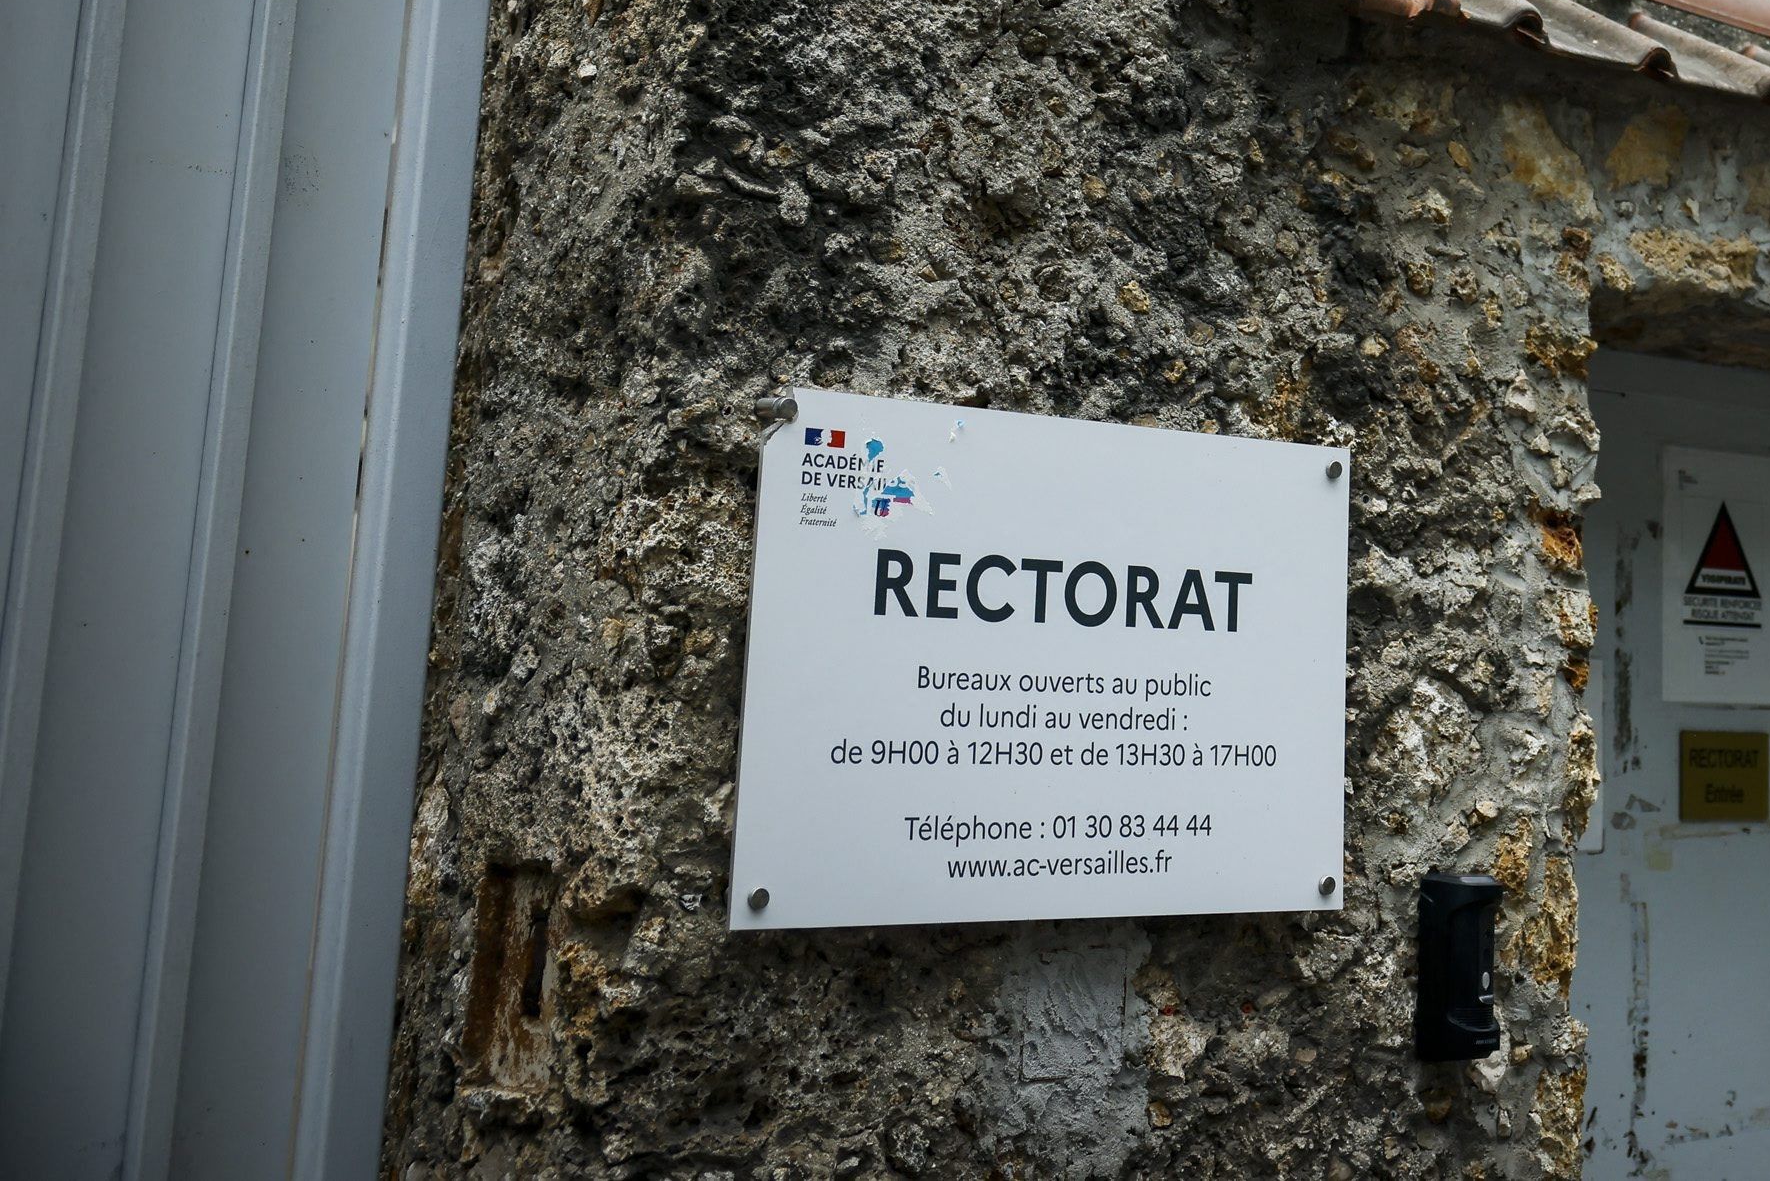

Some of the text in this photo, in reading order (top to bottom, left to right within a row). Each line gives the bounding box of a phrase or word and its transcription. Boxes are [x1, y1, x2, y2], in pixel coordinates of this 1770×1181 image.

[801, 471, 821, 486] DE
[800, 503, 828, 516] Égalité
[801, 492, 828, 503] Liberté
[799, 516, 838, 527] Fraternité
[873, 548, 1253, 633] RECTORAT
[917, 665, 1212, 703] Bureaux ouverts au public
[939, 702, 971, 728] du
[979, 702, 1037, 729] lundi
[1044, 711, 1071, 730] au
[1078, 706, 1176, 731] vendredi
[830, 738, 1277, 767] de 9H00 à 12H30 et de 13H30 à 17H00
[1689, 747, 1759, 769] RECTORAT
[1704, 782, 1745, 804] Entrée
[904, 814, 1033, 848] Téléphone
[1052, 814, 1076, 840] 01
[1084, 814, 1113, 839] 30
[1118, 814, 1146, 839] 83
[1152, 814, 1180, 838] 44
[1185, 814, 1212, 837] 44
[947, 848, 1173, 879] www.ac-versailles.fr
